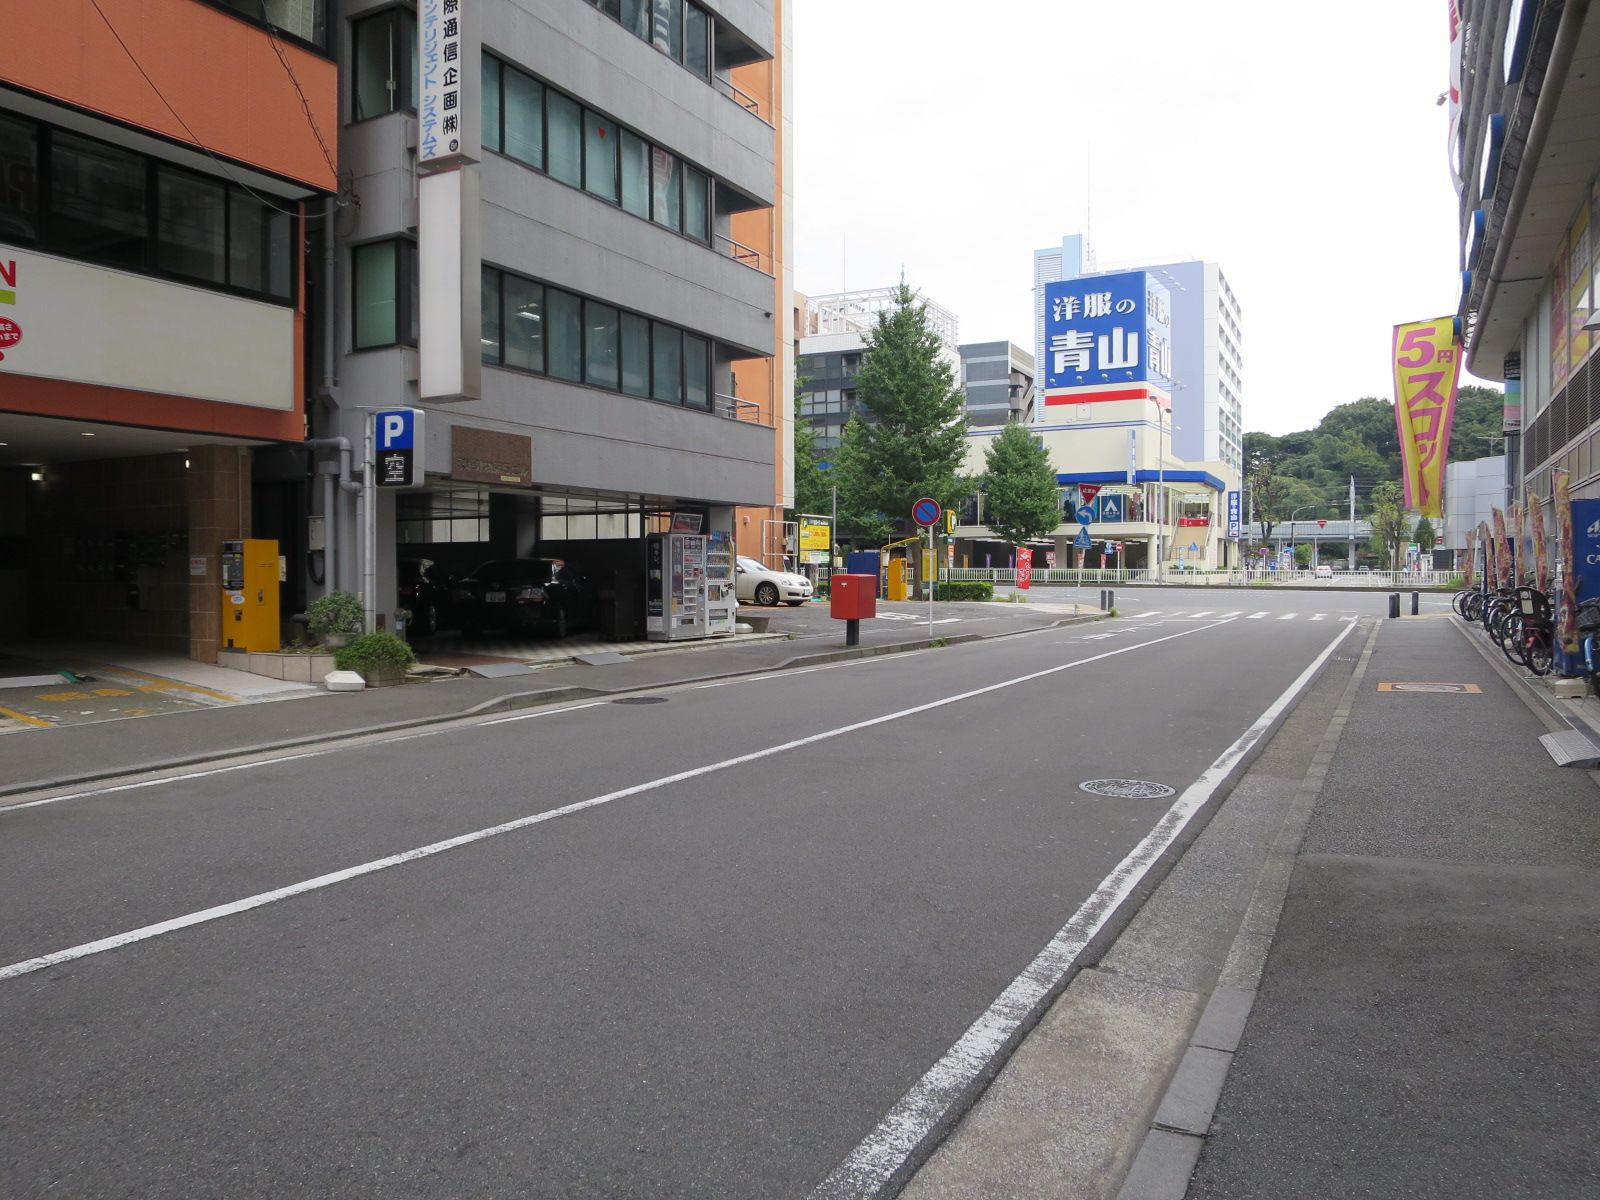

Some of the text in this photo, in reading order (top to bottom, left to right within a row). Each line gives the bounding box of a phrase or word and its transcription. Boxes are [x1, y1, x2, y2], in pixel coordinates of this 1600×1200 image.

[1052, 291, 1136, 322] 洋服の
[1049, 326, 1140, 374] 青山
[384, 415, 404, 448] P
[1230, 522, 1238, 530] P
